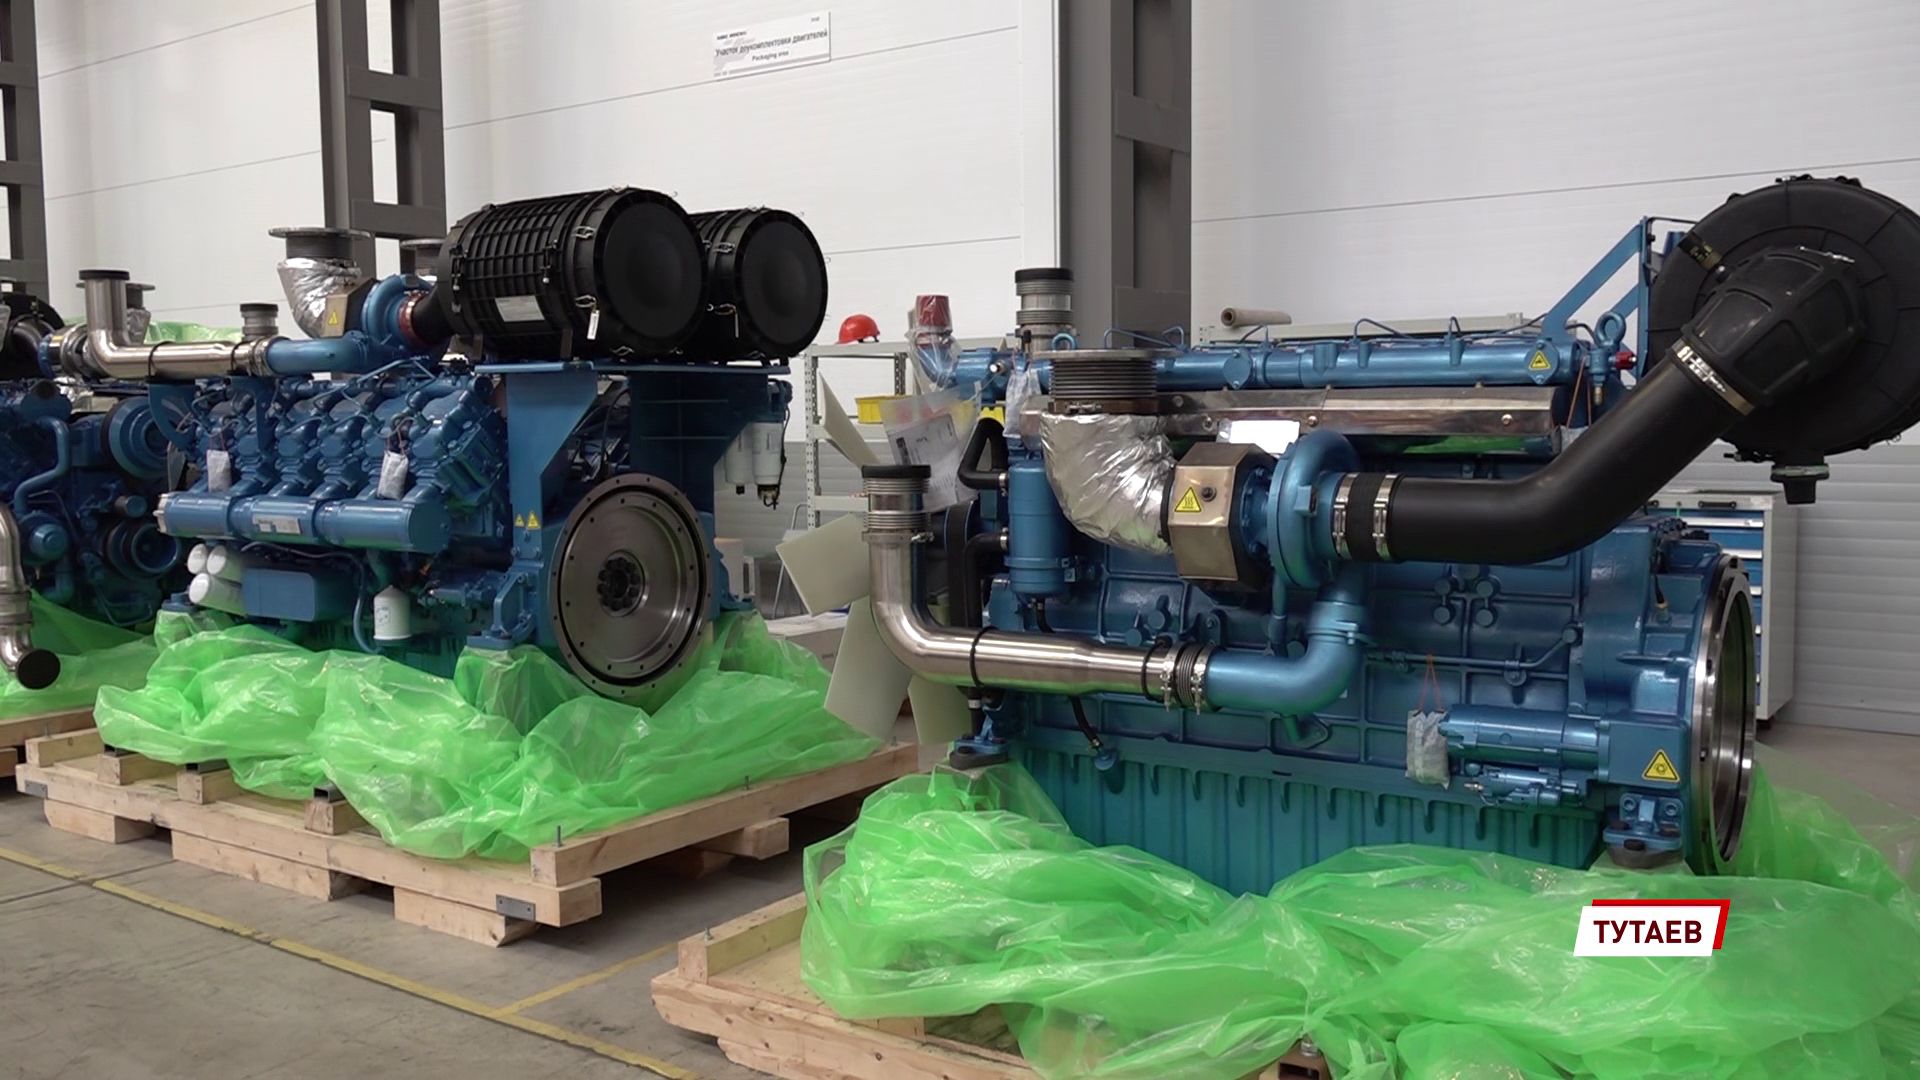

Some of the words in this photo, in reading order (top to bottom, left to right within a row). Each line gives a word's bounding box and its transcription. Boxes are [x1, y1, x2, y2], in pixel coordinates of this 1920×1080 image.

[715, 45, 739, 57] Участок
[792, 29, 828, 44] двигателей
[752, 52, 777, 61] Packaging
